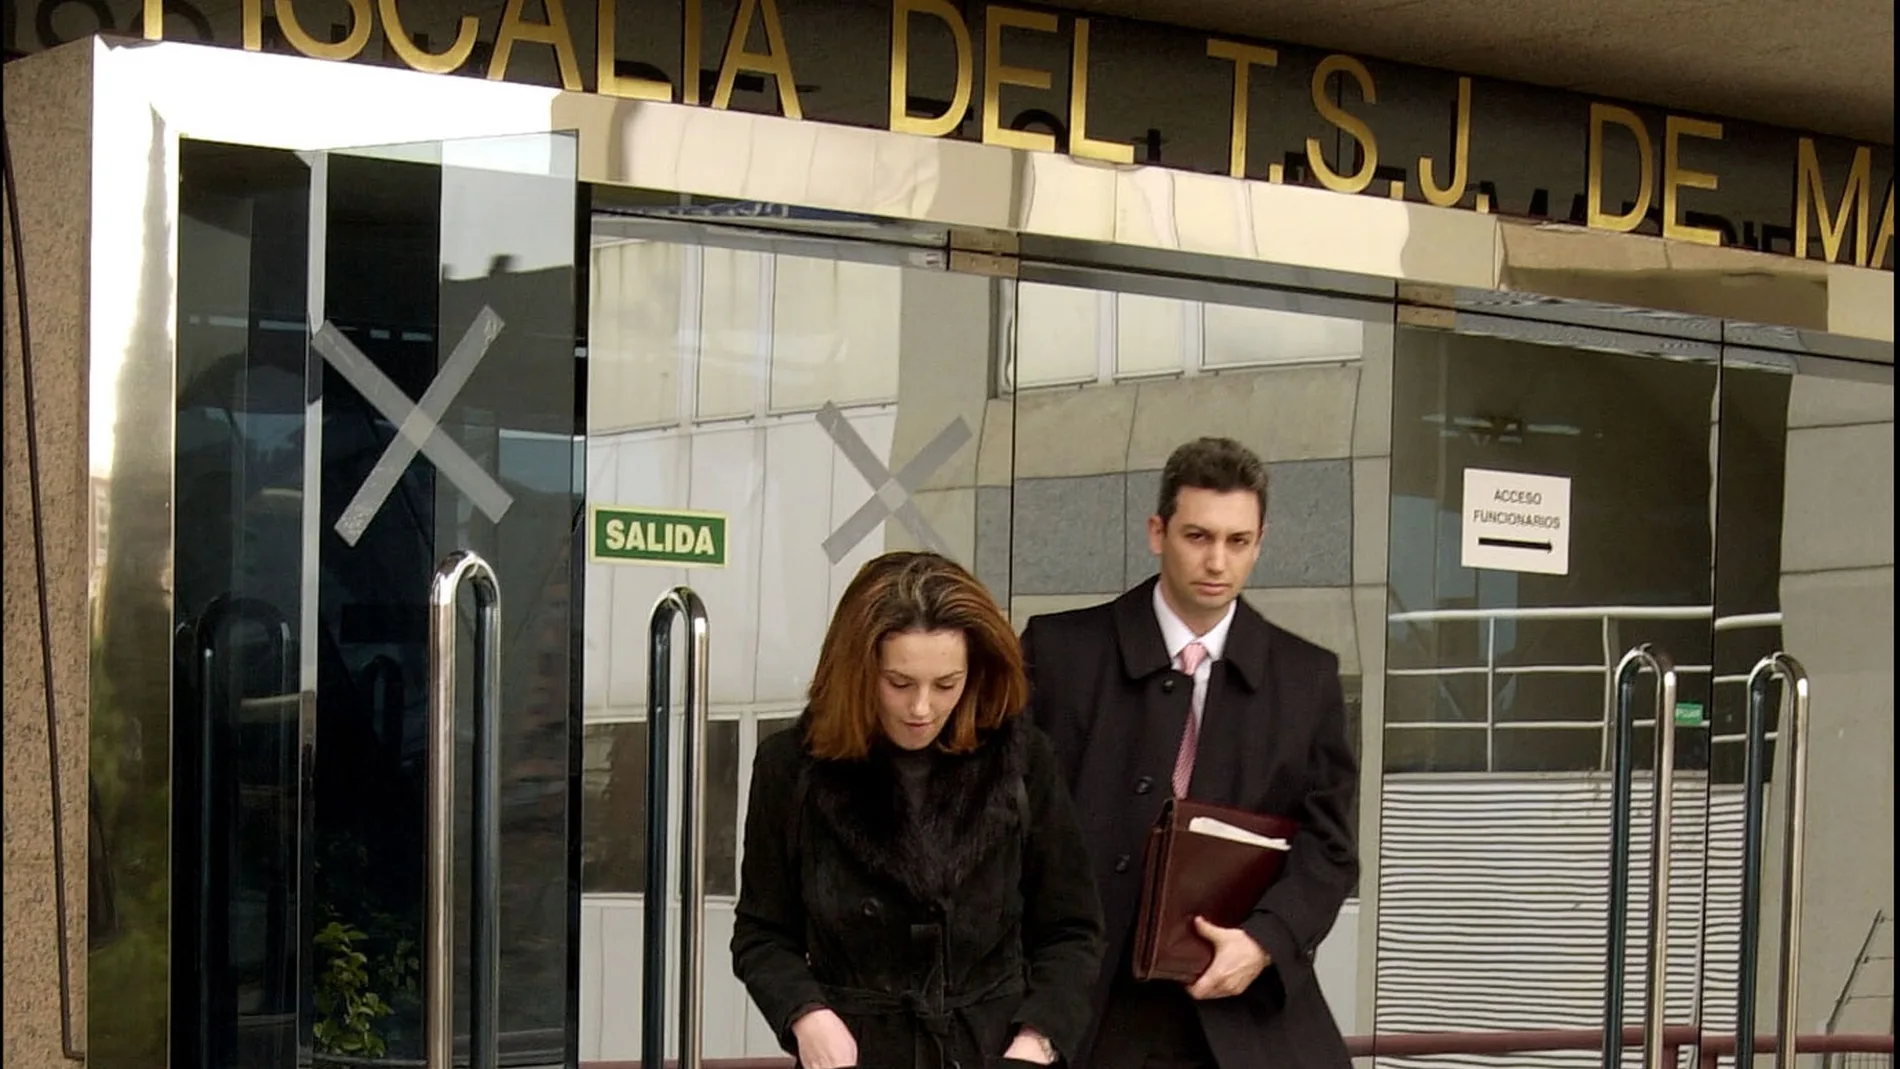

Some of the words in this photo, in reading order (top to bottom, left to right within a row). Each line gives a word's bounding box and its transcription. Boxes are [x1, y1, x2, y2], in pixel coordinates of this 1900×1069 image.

[890, 0, 1135, 164] DEL
[1587, 103, 1724, 246] DE
[1494, 489, 1542, 505] ACCESO
[1473, 509, 1561, 529] FUNCIONARIOS
[605, 519, 716, 556] SALIDA
